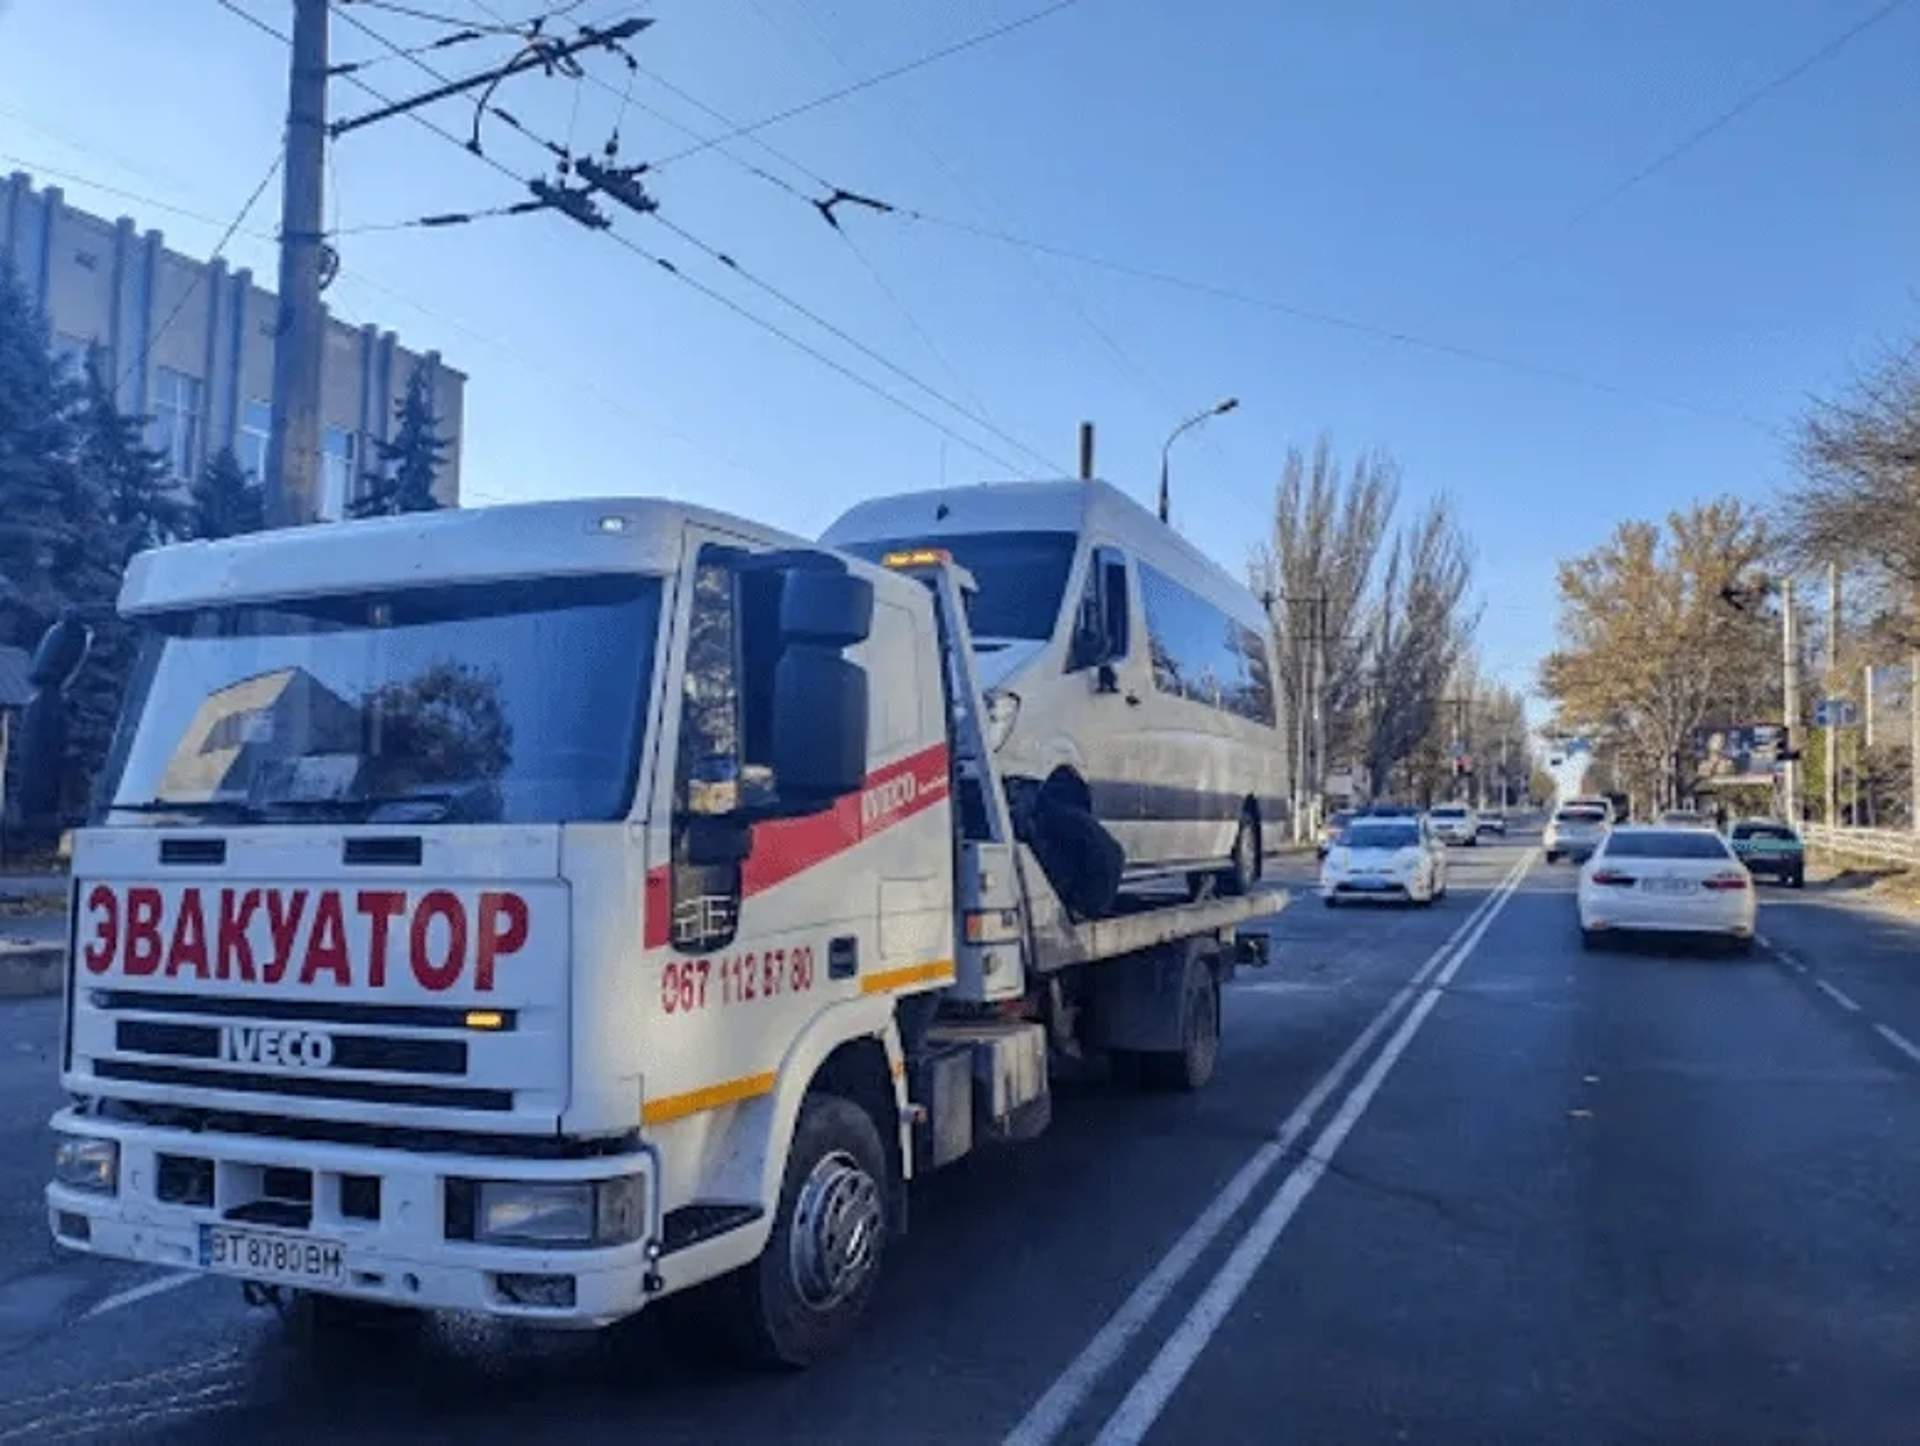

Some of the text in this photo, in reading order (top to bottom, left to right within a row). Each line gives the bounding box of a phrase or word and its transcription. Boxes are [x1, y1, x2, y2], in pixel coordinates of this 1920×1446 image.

[861, 772, 917, 824] IVECO
[84, 885, 529, 991] ЭВАКУАТОР
[661, 959, 711, 1014] 067
[720, 951, 757, 1006] 112
[220, 1026, 335, 1068] IVECO
